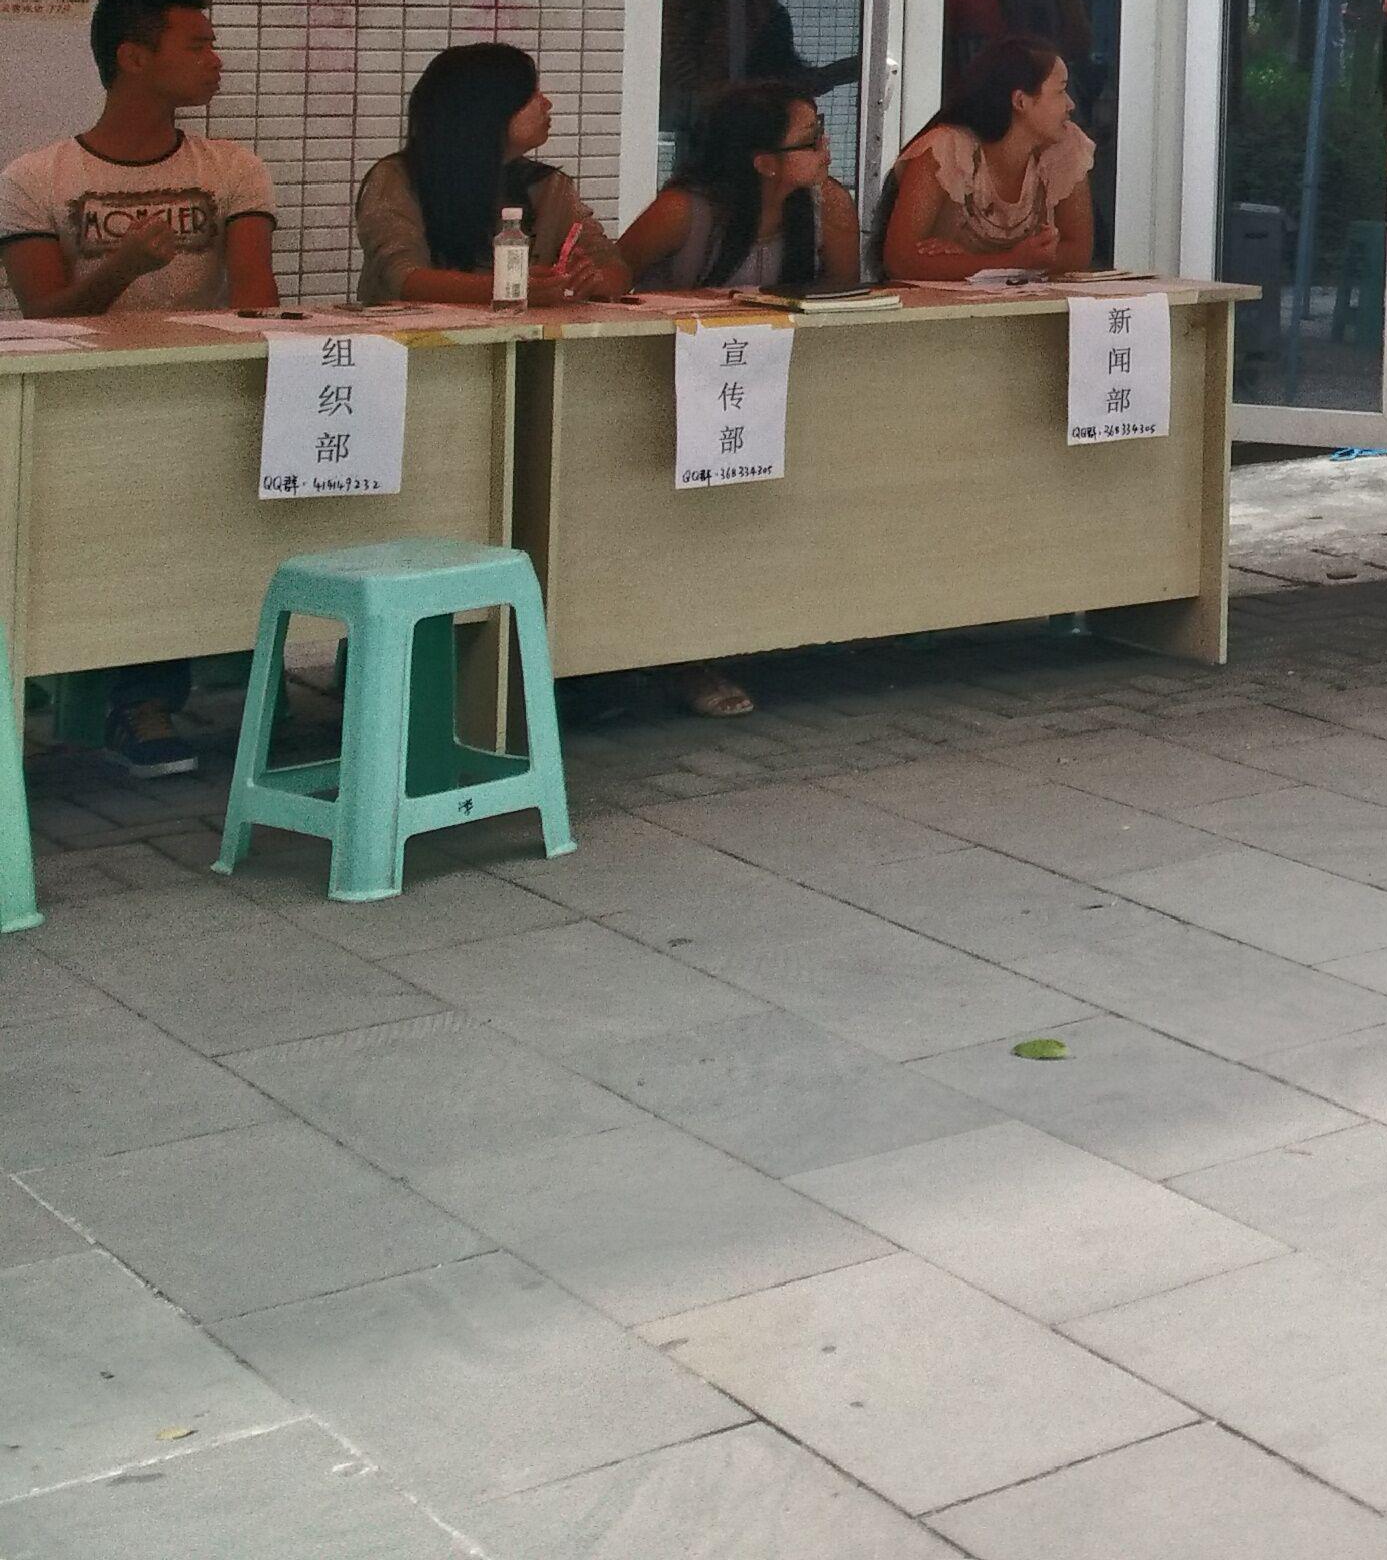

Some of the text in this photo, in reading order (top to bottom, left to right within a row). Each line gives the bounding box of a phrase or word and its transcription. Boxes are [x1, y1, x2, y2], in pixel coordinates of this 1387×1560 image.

[315, 337, 355, 465] 组织部
[718, 339, 748, 456] 宣传部
[1106, 307, 1131, 415] 新闻部
